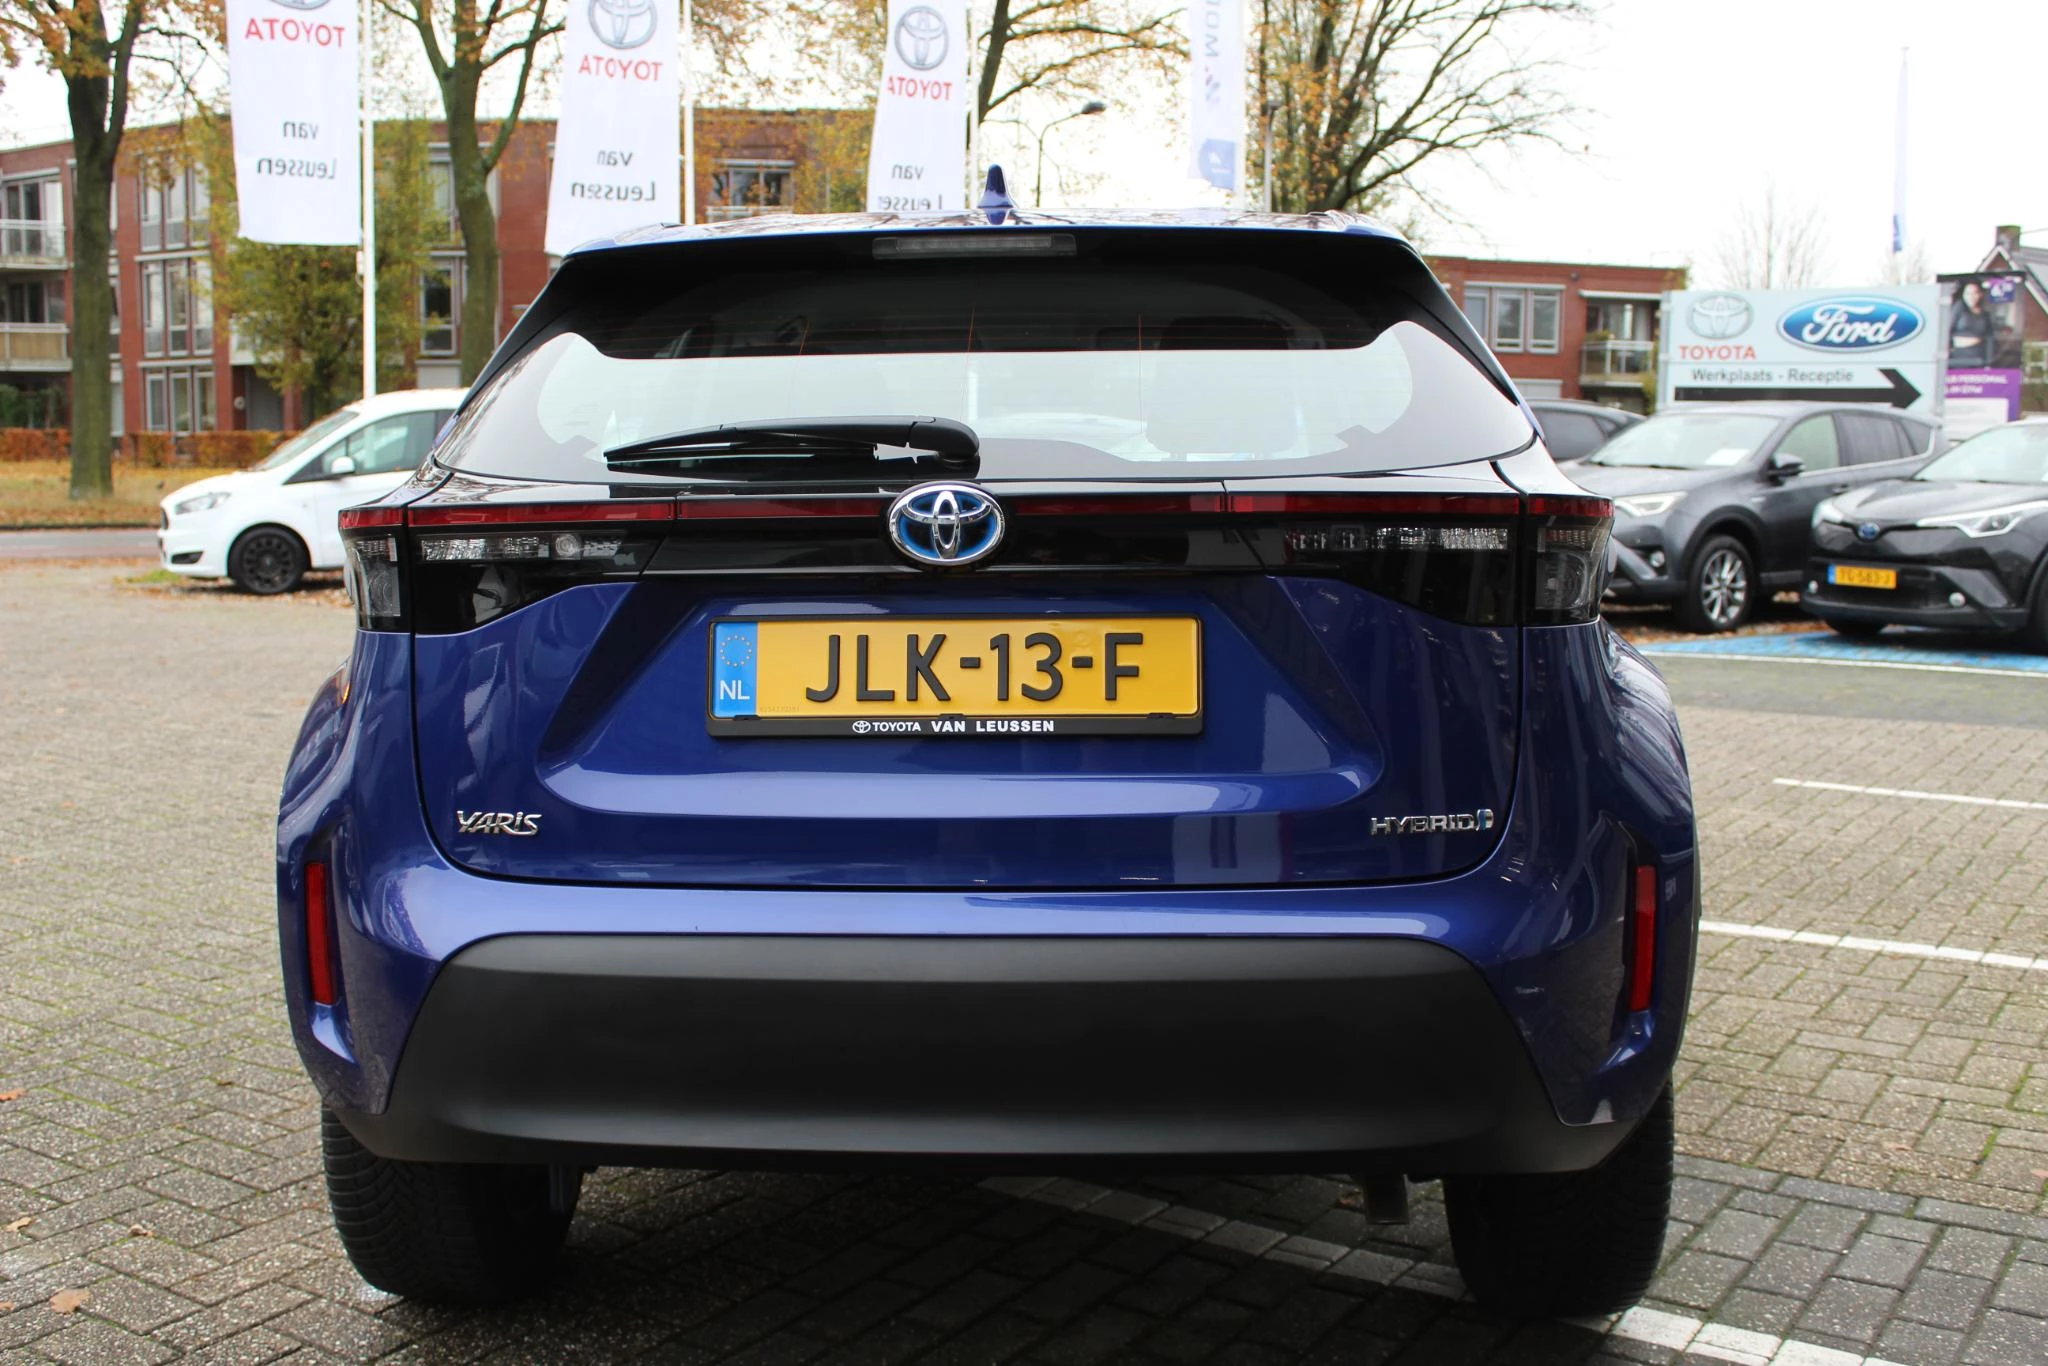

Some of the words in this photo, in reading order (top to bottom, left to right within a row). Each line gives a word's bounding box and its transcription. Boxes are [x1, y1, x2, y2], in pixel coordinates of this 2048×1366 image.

[1802, 304, 1898, 344] Ford
[1679, 345, 1756, 360] TOYOTA
[1692, 369, 1773, 384] Werkplaats
[1788, 368, 1853, 384] Receptie
[805, 632, 1144, 702] JLK-13-F
[719, 681, 751, 701] NL
[872, 722, 921, 733] TOYOTA
[931, 721, 966, 733] VAN
[976, 721, 1055, 733] LEUSSEN
[1370, 813, 1476, 835] HYBRID
